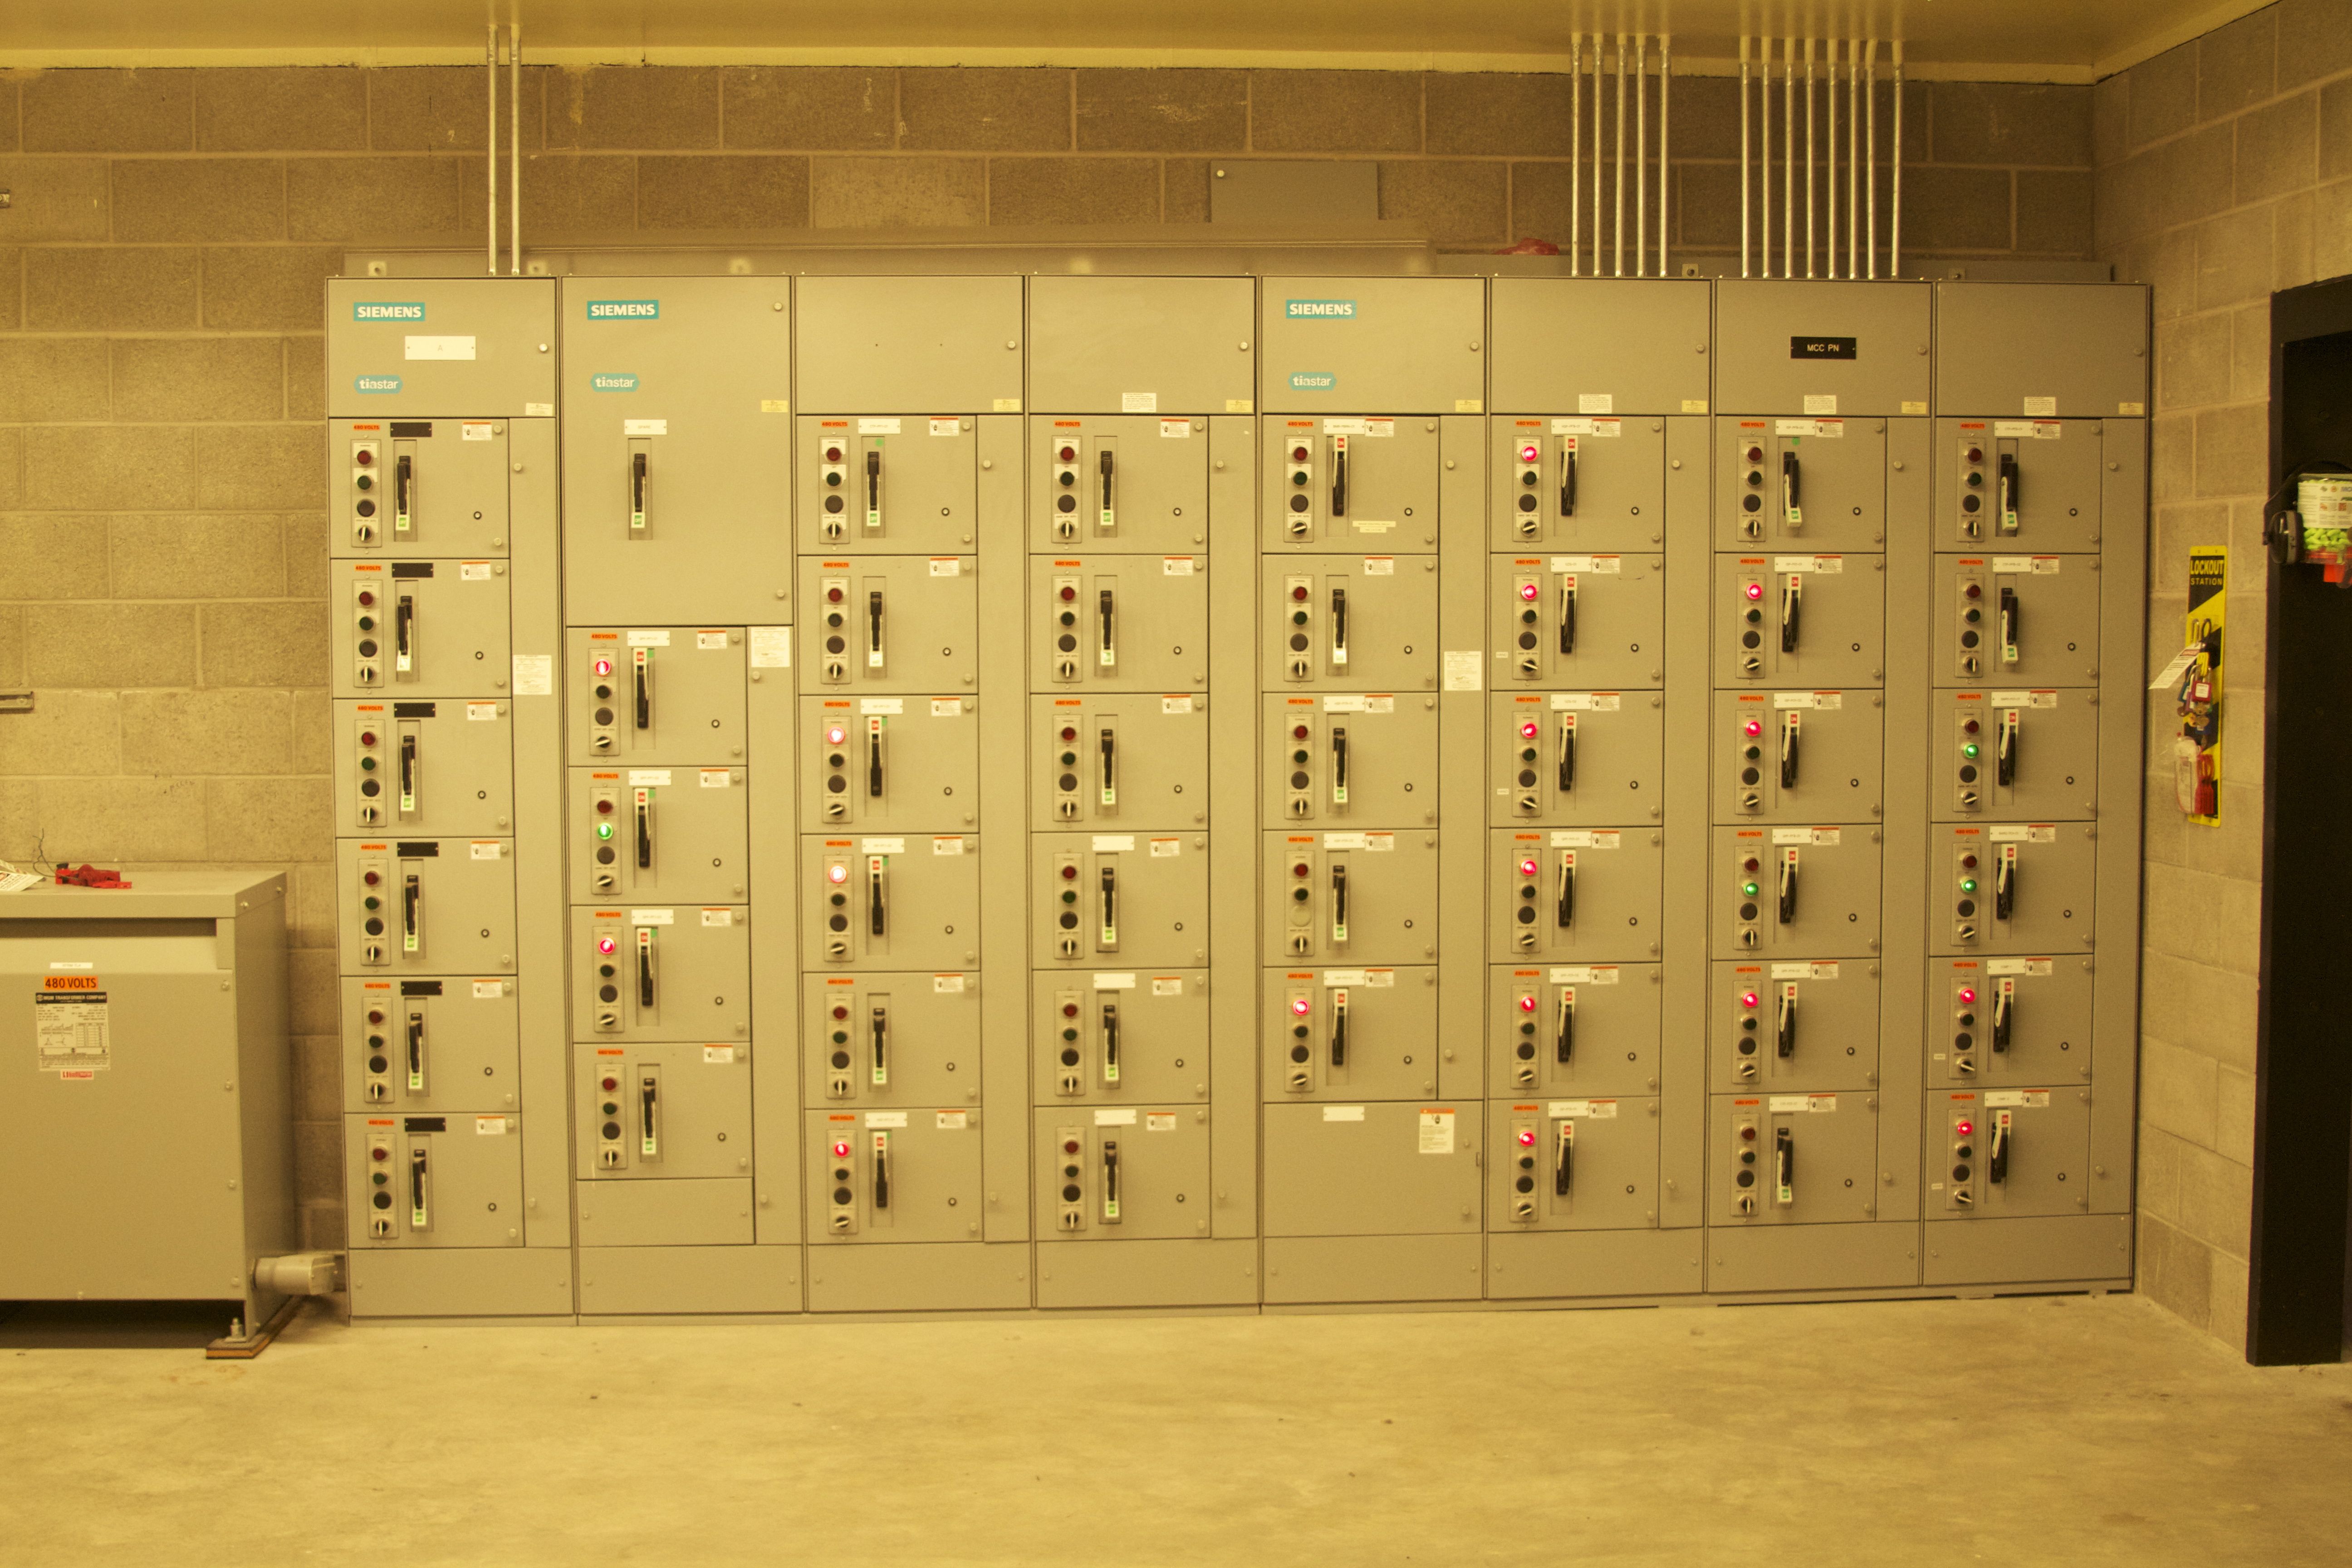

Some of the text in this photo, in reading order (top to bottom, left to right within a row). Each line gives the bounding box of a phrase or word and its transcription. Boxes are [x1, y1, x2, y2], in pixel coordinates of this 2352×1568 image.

[358, 306, 421, 318] SIEMENS
[591, 304, 655, 316] SIEMENS
[1289, 304, 1352, 315] SIEMENS
[1828, 344, 1839, 352] PN
[359, 378, 398, 389] tiastar
[595, 377, 635, 388] tiastar
[1293, 375, 1332, 387] tiastar
[2190, 560, 2224, 575] LOCKOUT
[45, 978, 96, 988] 480 VOLTS
